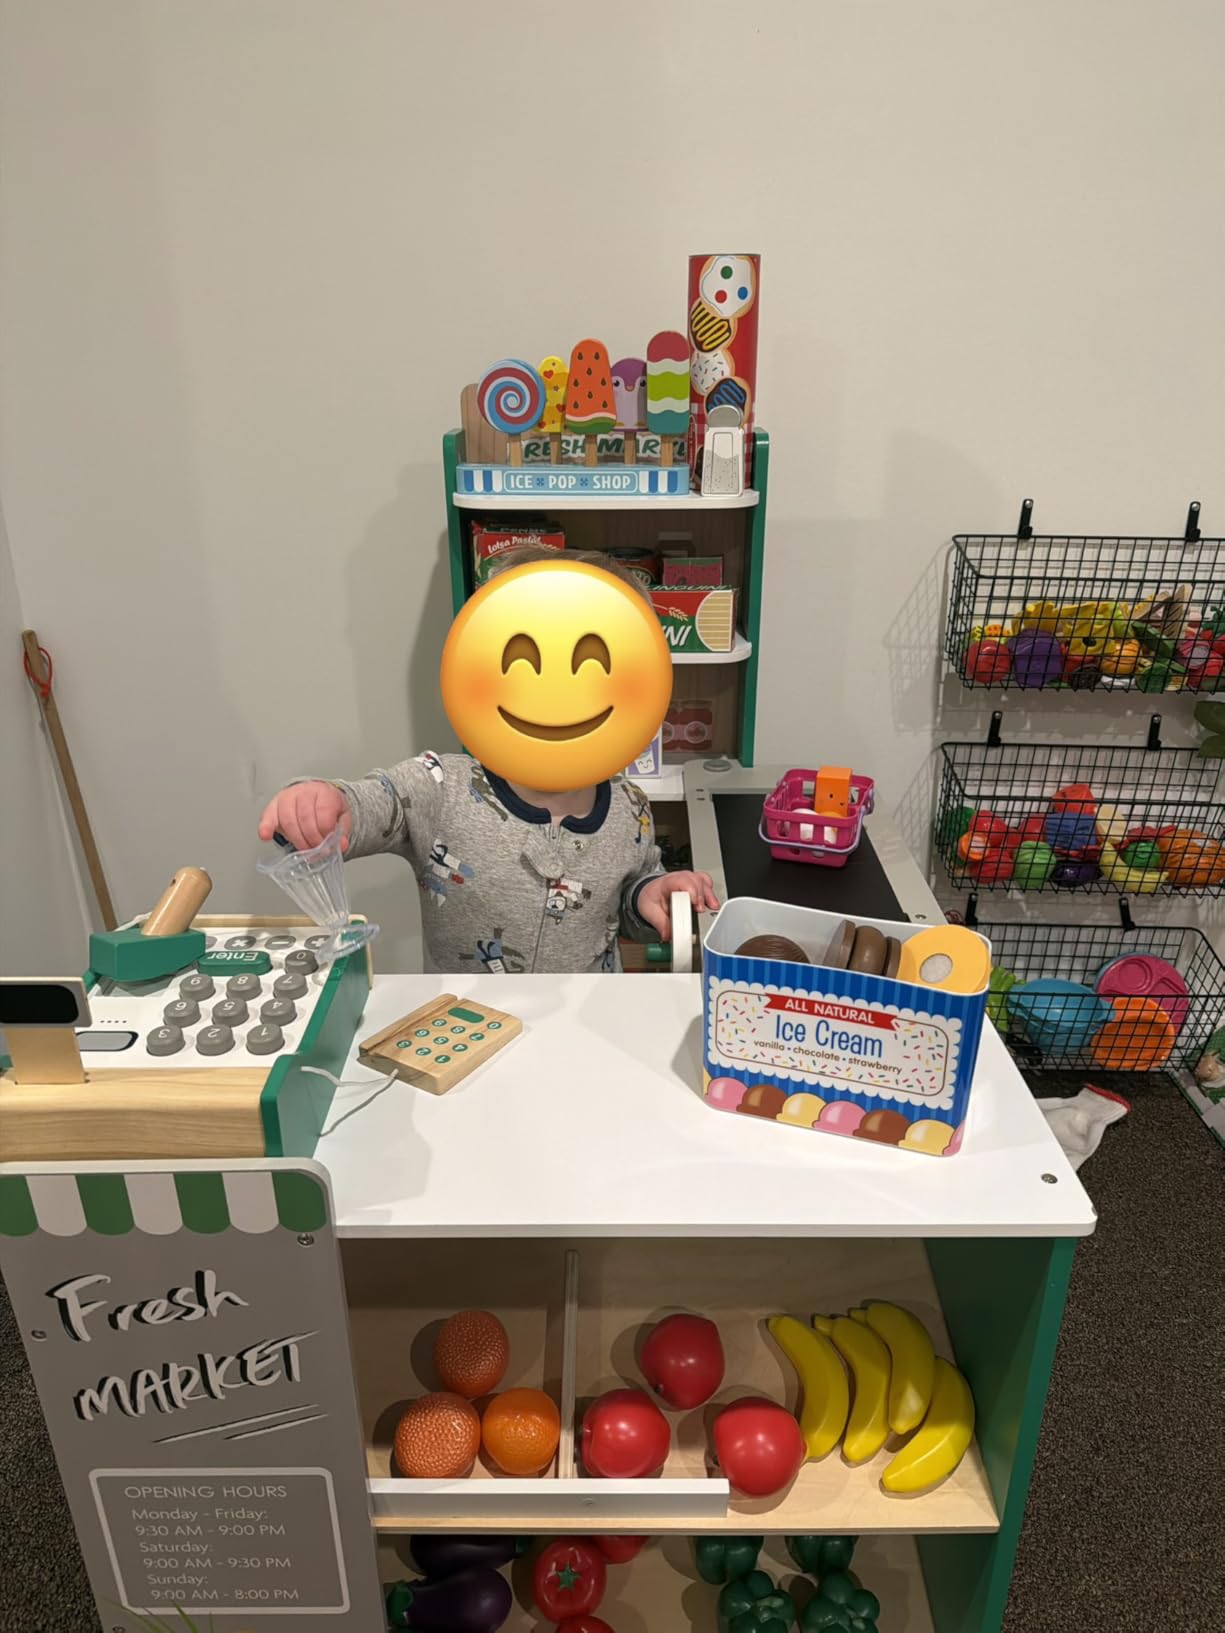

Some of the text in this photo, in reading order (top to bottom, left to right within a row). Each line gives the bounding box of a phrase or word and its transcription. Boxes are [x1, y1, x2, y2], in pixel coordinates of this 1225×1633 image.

[510, 475, 631, 489] ICE POP SHOP
[487, 539, 511, 554] Lotsa
[207, 951, 259, 961] Enter
[238, 976, 248, 985] 8
[785, 998, 875, 1024] ALL NATURAL
[775, 1014, 883, 1058] Ice Cream
[753, 1039, 903, 1075] vanilla chocolate strawberry
[45, 1269, 249, 1342] Fresh
[72, 1330, 320, 1421] MARKET
[124, 1485, 288, 1498] OPENING HOURS
[131, 1508, 198, 1521] Monday
[215, 1508, 268, 1521] Friday:
[135, 1525, 169, 1536] 9:30
[175, 1525, 203, 1536] AM
[218, 1525, 255, 1536] 9:00
[259, 1524, 286, 1535] PM
[143, 1558, 179, 1569] 9:00
[184, 1558, 213, 1568] AM
[227, 1557, 261, 1568] 9:30
[265, 1557, 292, 1568] PM
[146, 1573, 209, 1587] Sunday:
[151, 1589, 186, 1600] 9:00
[191, 1589, 219, 1600] AM
[234, 1589, 269, 1600] 8:00
[274, 1588, 300, 1599] PM
